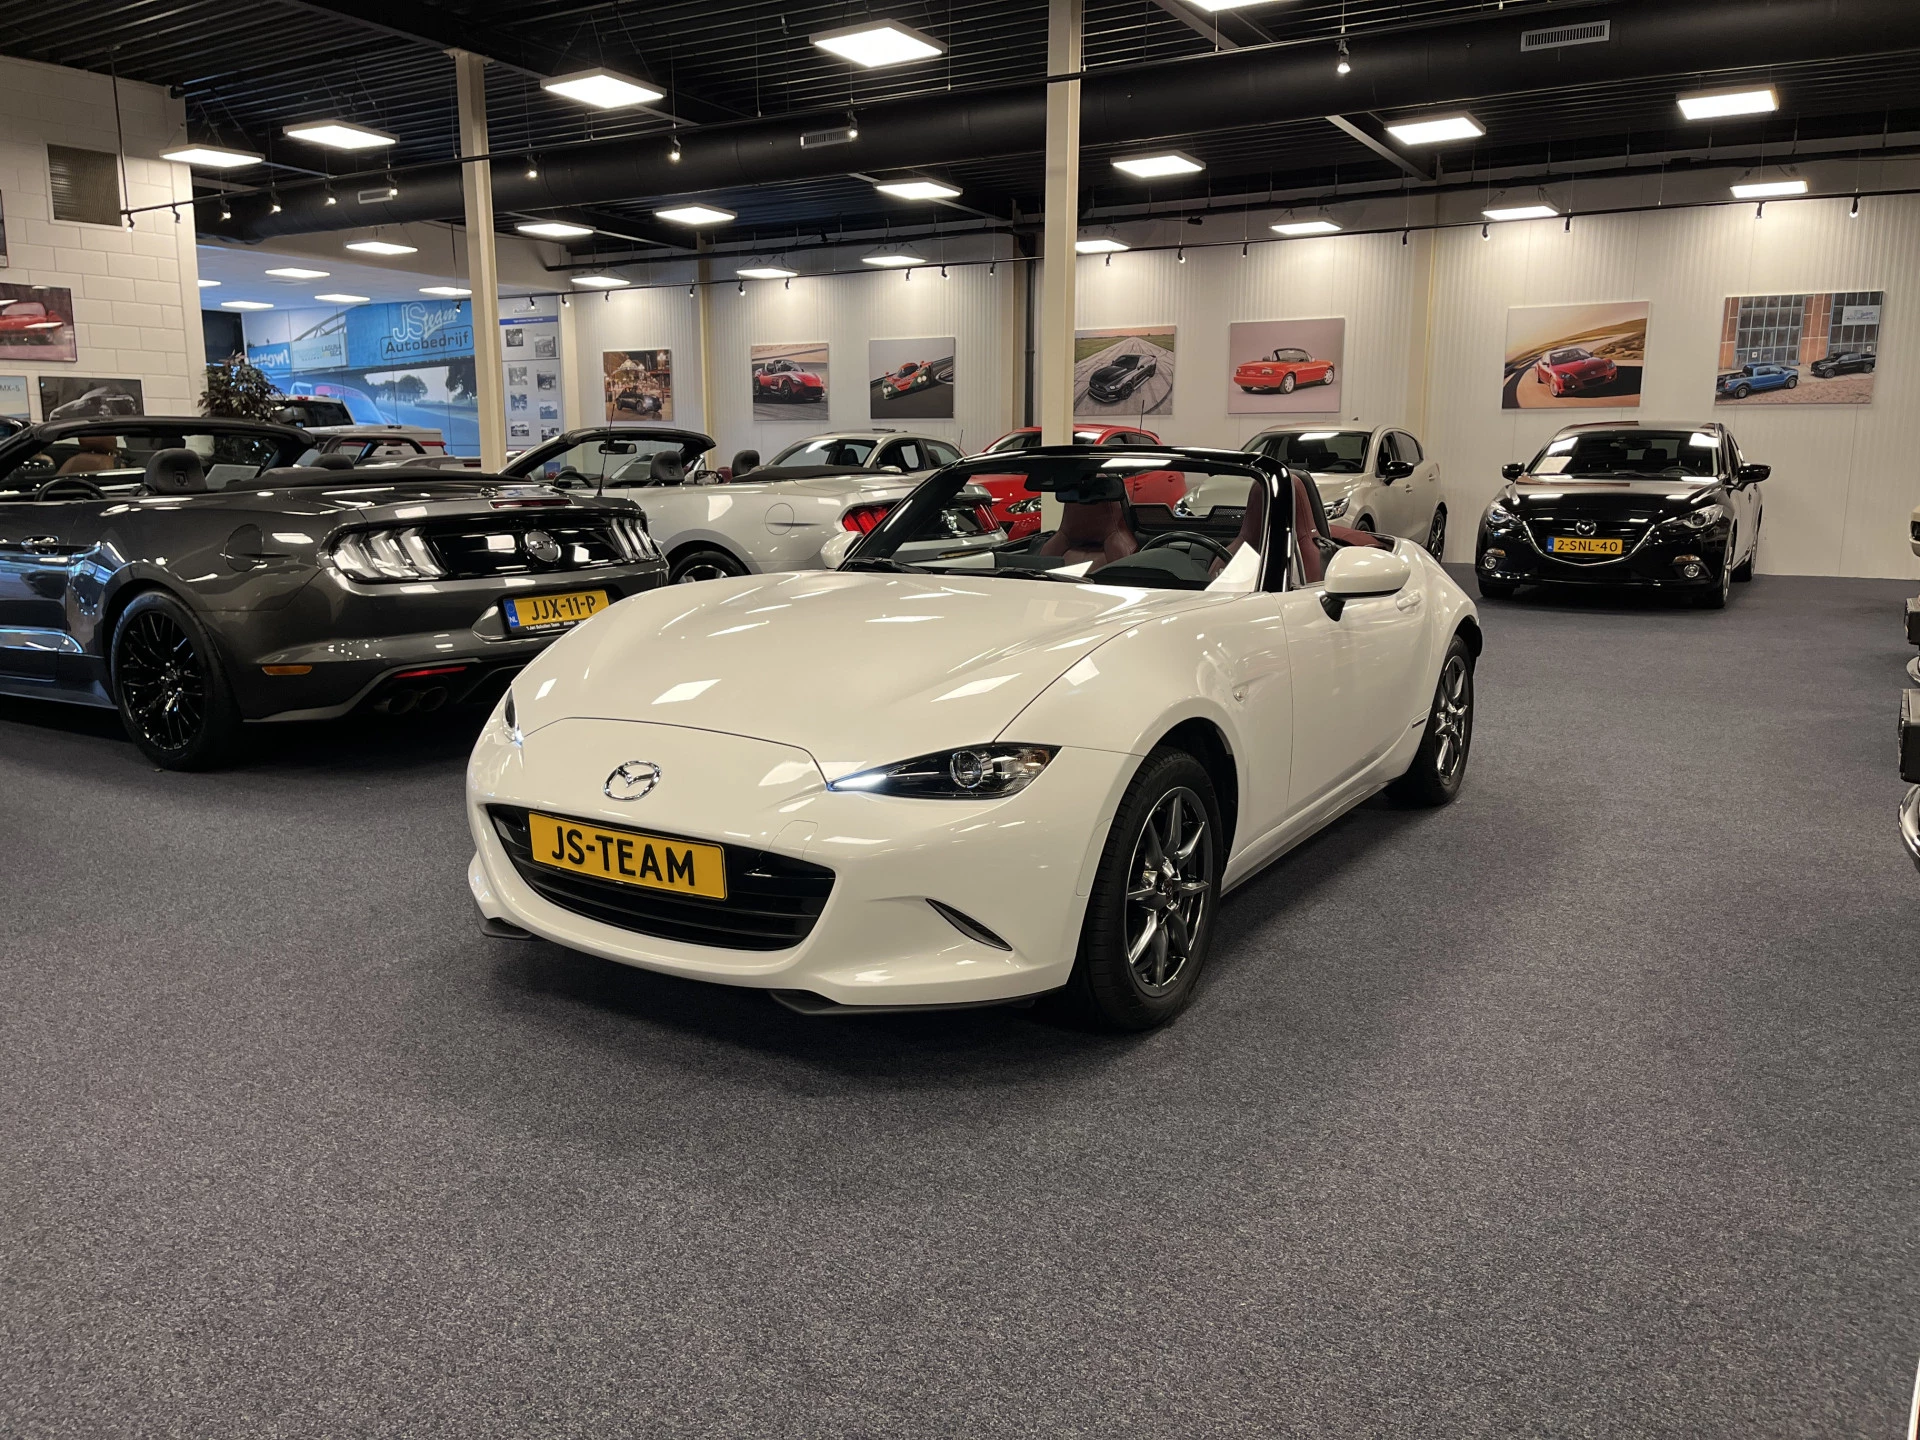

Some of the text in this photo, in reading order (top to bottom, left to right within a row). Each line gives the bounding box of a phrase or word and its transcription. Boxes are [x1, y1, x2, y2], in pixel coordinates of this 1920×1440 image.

[385, 331, 469, 354] Autobedrijf
[1557, 539, 1618, 552] 2-SNL-40
[532, 595, 596, 621] JJX-11-P
[551, 825, 696, 887] JS-TEAM
